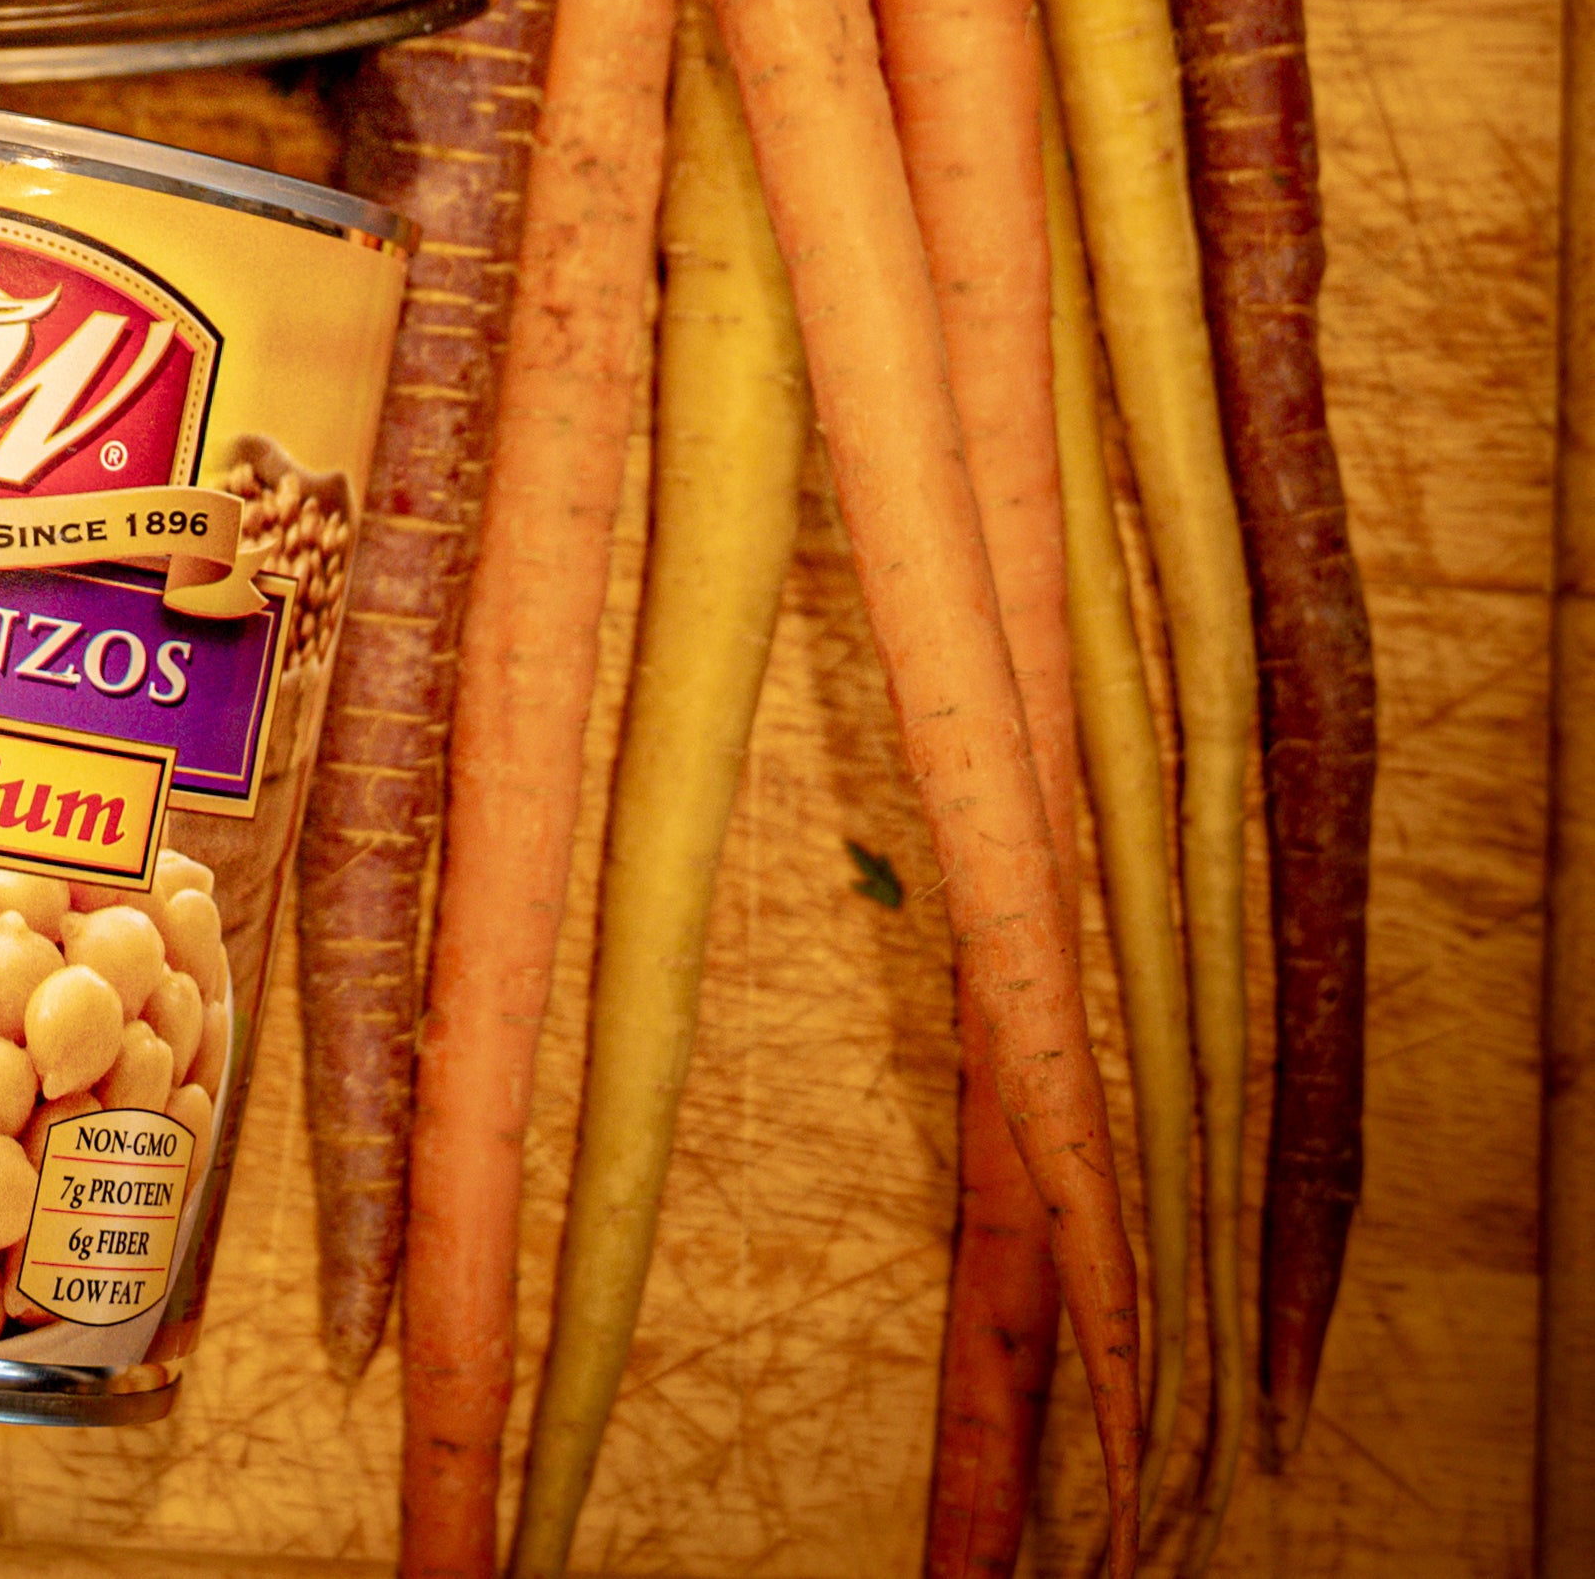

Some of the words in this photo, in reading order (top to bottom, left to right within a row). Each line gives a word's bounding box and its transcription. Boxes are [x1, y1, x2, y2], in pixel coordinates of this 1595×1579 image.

[125, 510, 209, 539] 1896
[75, 1126, 178, 1158] NON-GMO
[59, 1176, 86, 1209] 7g
[88, 1178, 175, 1207] PROTEIN
[68, 1227, 94, 1261] 6g
[96, 1229, 150, 1256] FIBER
[52, 1277, 108, 1303] LOW
[109, 1280, 146, 1305] FAT
